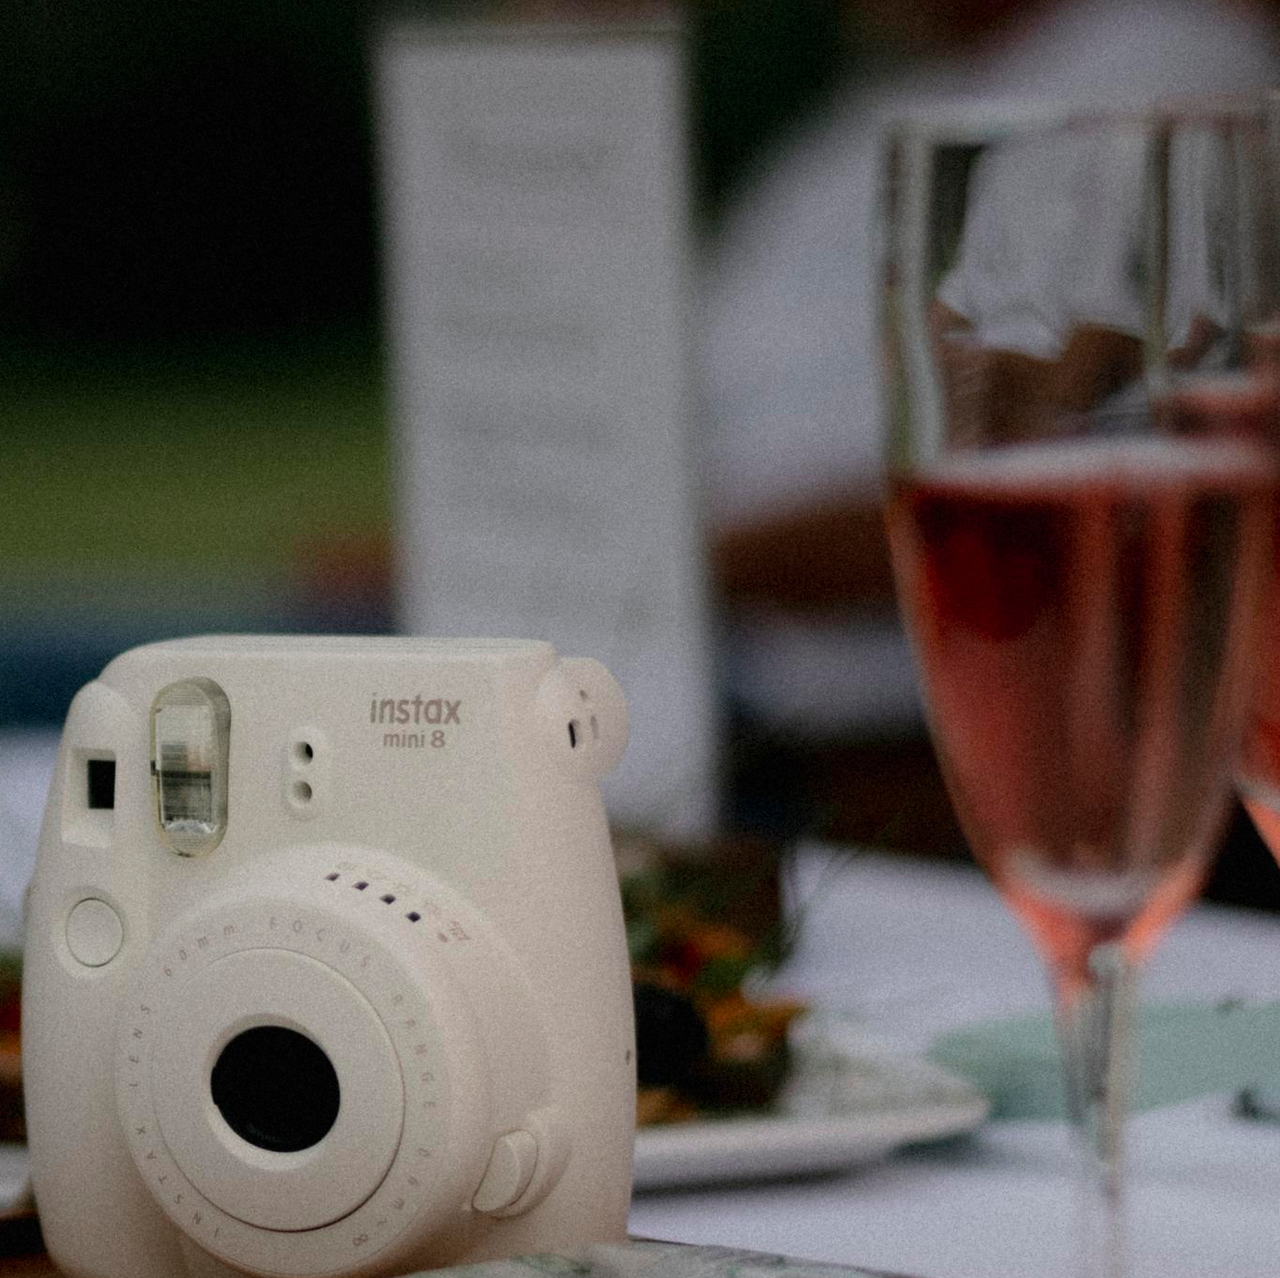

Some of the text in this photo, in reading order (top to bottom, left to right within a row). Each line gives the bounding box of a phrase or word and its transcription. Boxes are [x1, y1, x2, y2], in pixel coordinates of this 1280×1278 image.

[369, 692, 462, 725] instax
[382, 729, 446, 749] mini 8
[269, 916, 371, 968] FOCUS
[128, 1003, 151, 1088] LENS
[135, 1125, 220, 1239] INSTAX
